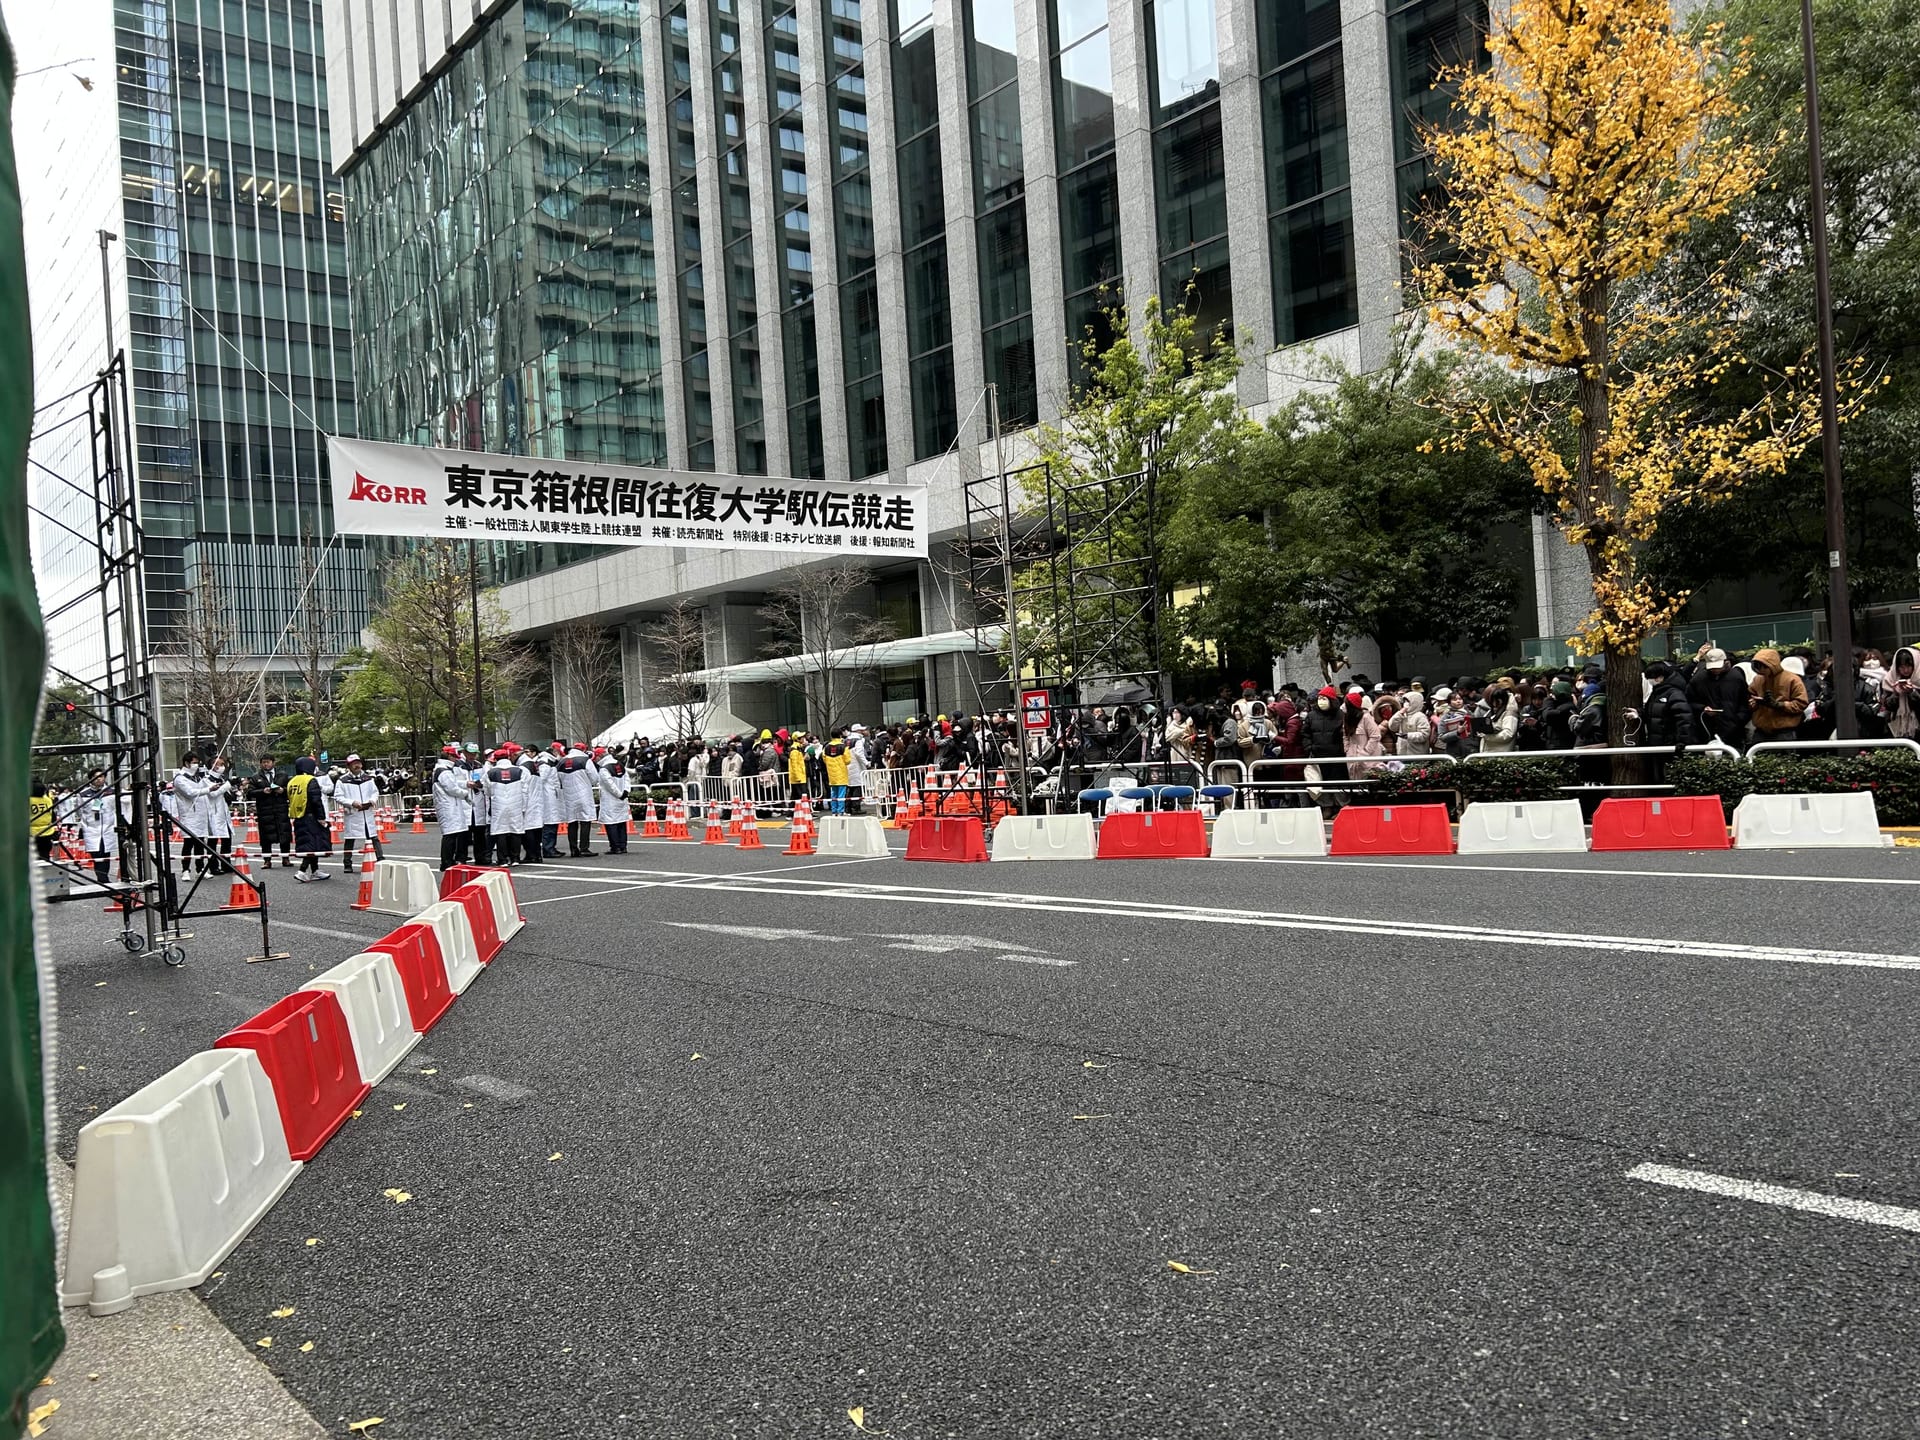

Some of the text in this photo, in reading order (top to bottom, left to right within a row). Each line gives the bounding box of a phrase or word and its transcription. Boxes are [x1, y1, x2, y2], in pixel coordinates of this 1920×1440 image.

[444, 463, 914, 531] 東京箱根間往復大学駅伝競走
